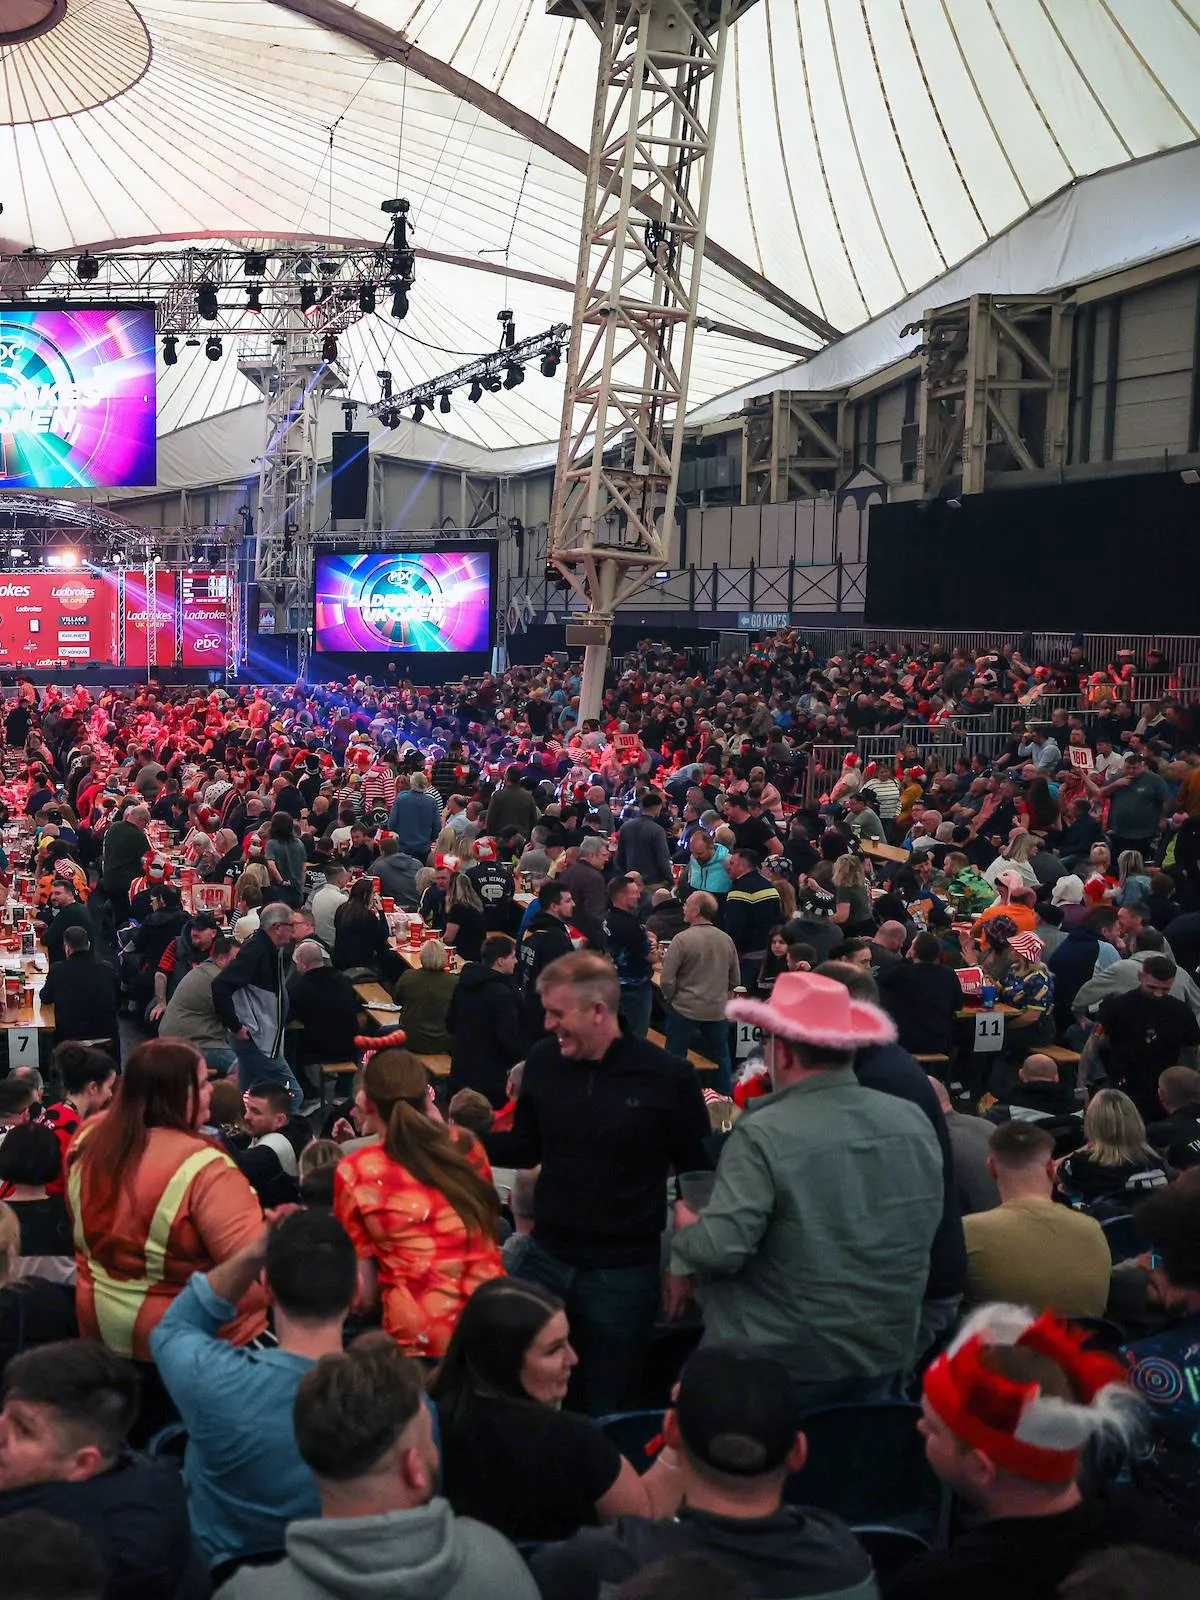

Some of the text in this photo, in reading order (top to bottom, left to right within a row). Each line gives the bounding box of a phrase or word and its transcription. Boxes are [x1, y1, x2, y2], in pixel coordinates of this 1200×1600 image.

[51, 587, 96, 597] Ladbrokes
[751, 614, 787, 628] GO KARTS
[196, 638, 220, 649] PDC
[740, 1025, 763, 1042] 10
[979, 1019, 1001, 1037] 11
[17, 1035, 29, 1053] 7
